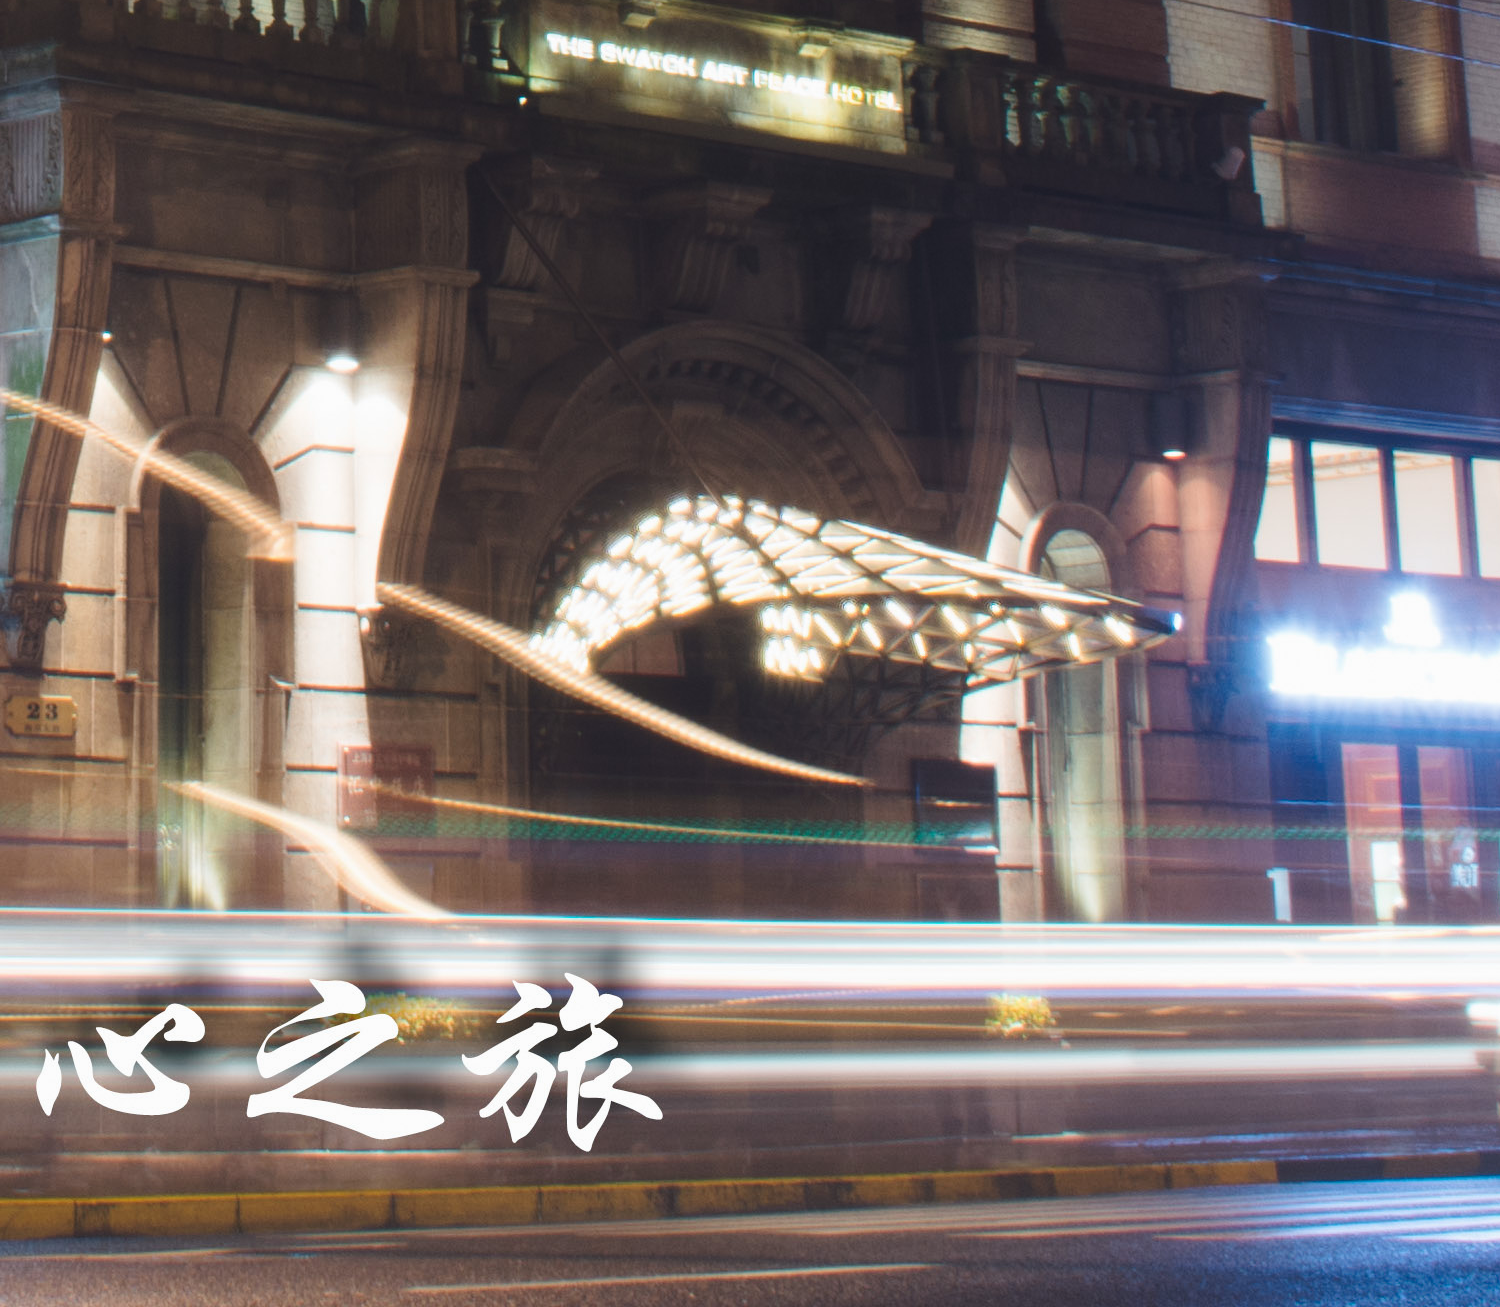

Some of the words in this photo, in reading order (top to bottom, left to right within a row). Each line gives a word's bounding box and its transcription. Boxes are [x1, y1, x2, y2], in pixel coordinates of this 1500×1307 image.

[545, 32, 595, 61] THE
[599, 41, 698, 77] SWATCH
[701, 60, 750, 87] ART
[831, 82, 904, 113] HOTEL
[27, 701, 58, 721] 23
